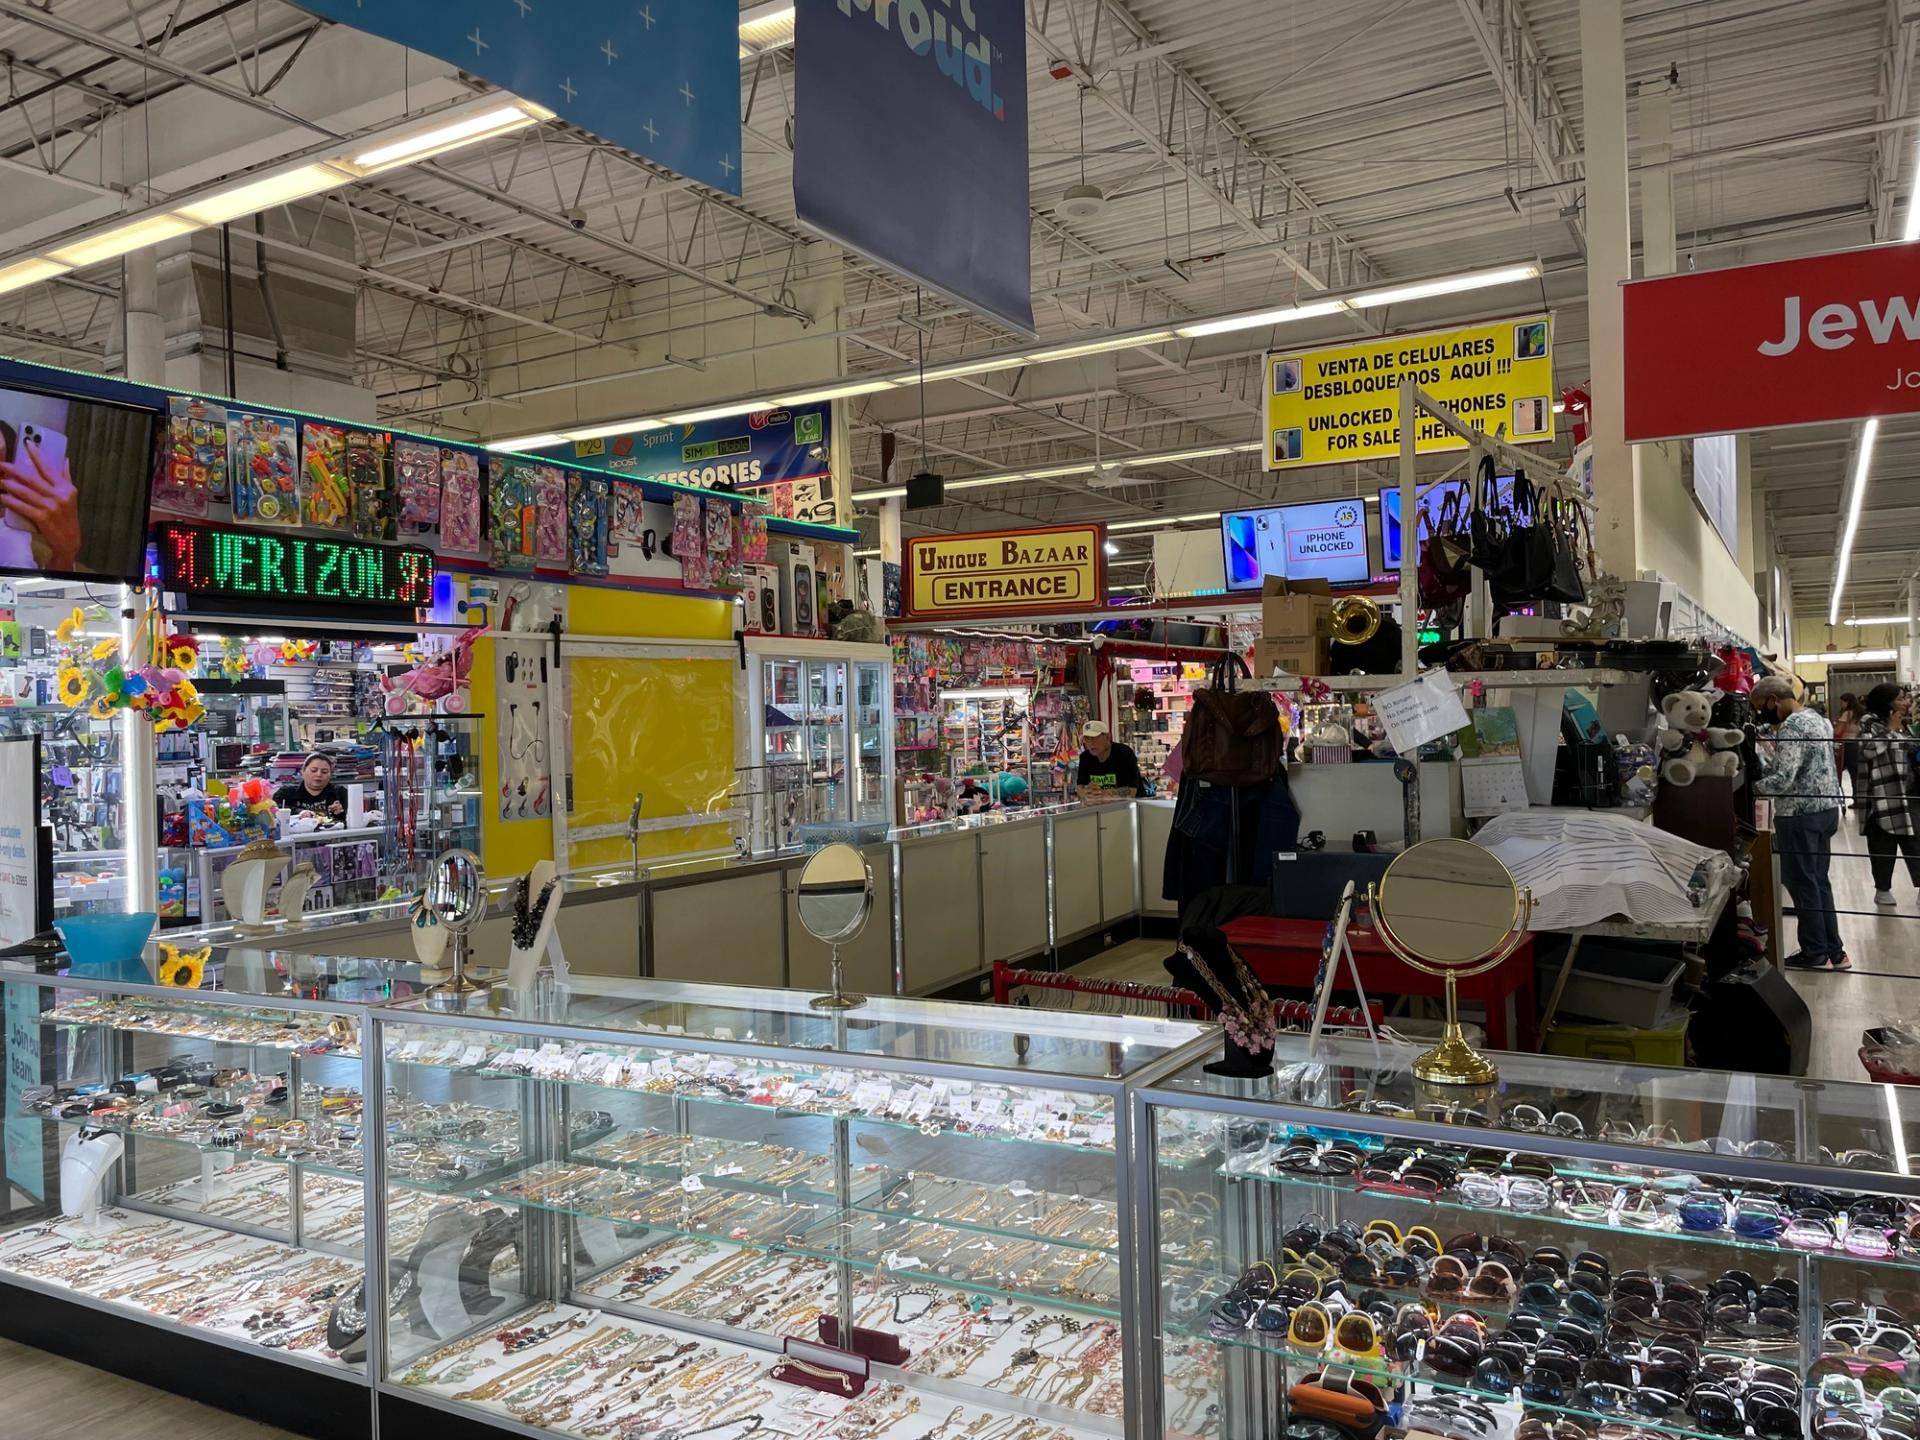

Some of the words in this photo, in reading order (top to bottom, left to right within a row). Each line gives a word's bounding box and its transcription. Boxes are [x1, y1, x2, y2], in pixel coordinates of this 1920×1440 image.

[1757, 296, 1920, 357] Jew
[1318, 357, 1368, 378] VENTA
[1373, 353, 1394, 371] DE
[1398, 338, 1495, 367] CELULARES
[1304, 367, 1440, 401] DESBLOQUEADOS
[1450, 357, 1491, 382] AQUÍ
[1496, 357, 1512, 375] !!!
[1308, 407, 1393, 433] UNLOCKED
[1397, 403, 1432, 420] EL
[642, 431, 674, 449] Sprint
[1327, 432, 1358, 451] FOR
[608, 456, 638, 469] boost
[1299, 541, 1354, 554] UNLOCKED
[1306, 531, 1345, 542] IPHONE
[918, 547, 987, 571] UNIQUE
[1000, 540, 1088, 565] BAZAAR
[944, 575, 1067, 601] ENTRANCE
[10, 1022, 28, 1052] Join
[11, 1051, 35, 1086] team.
